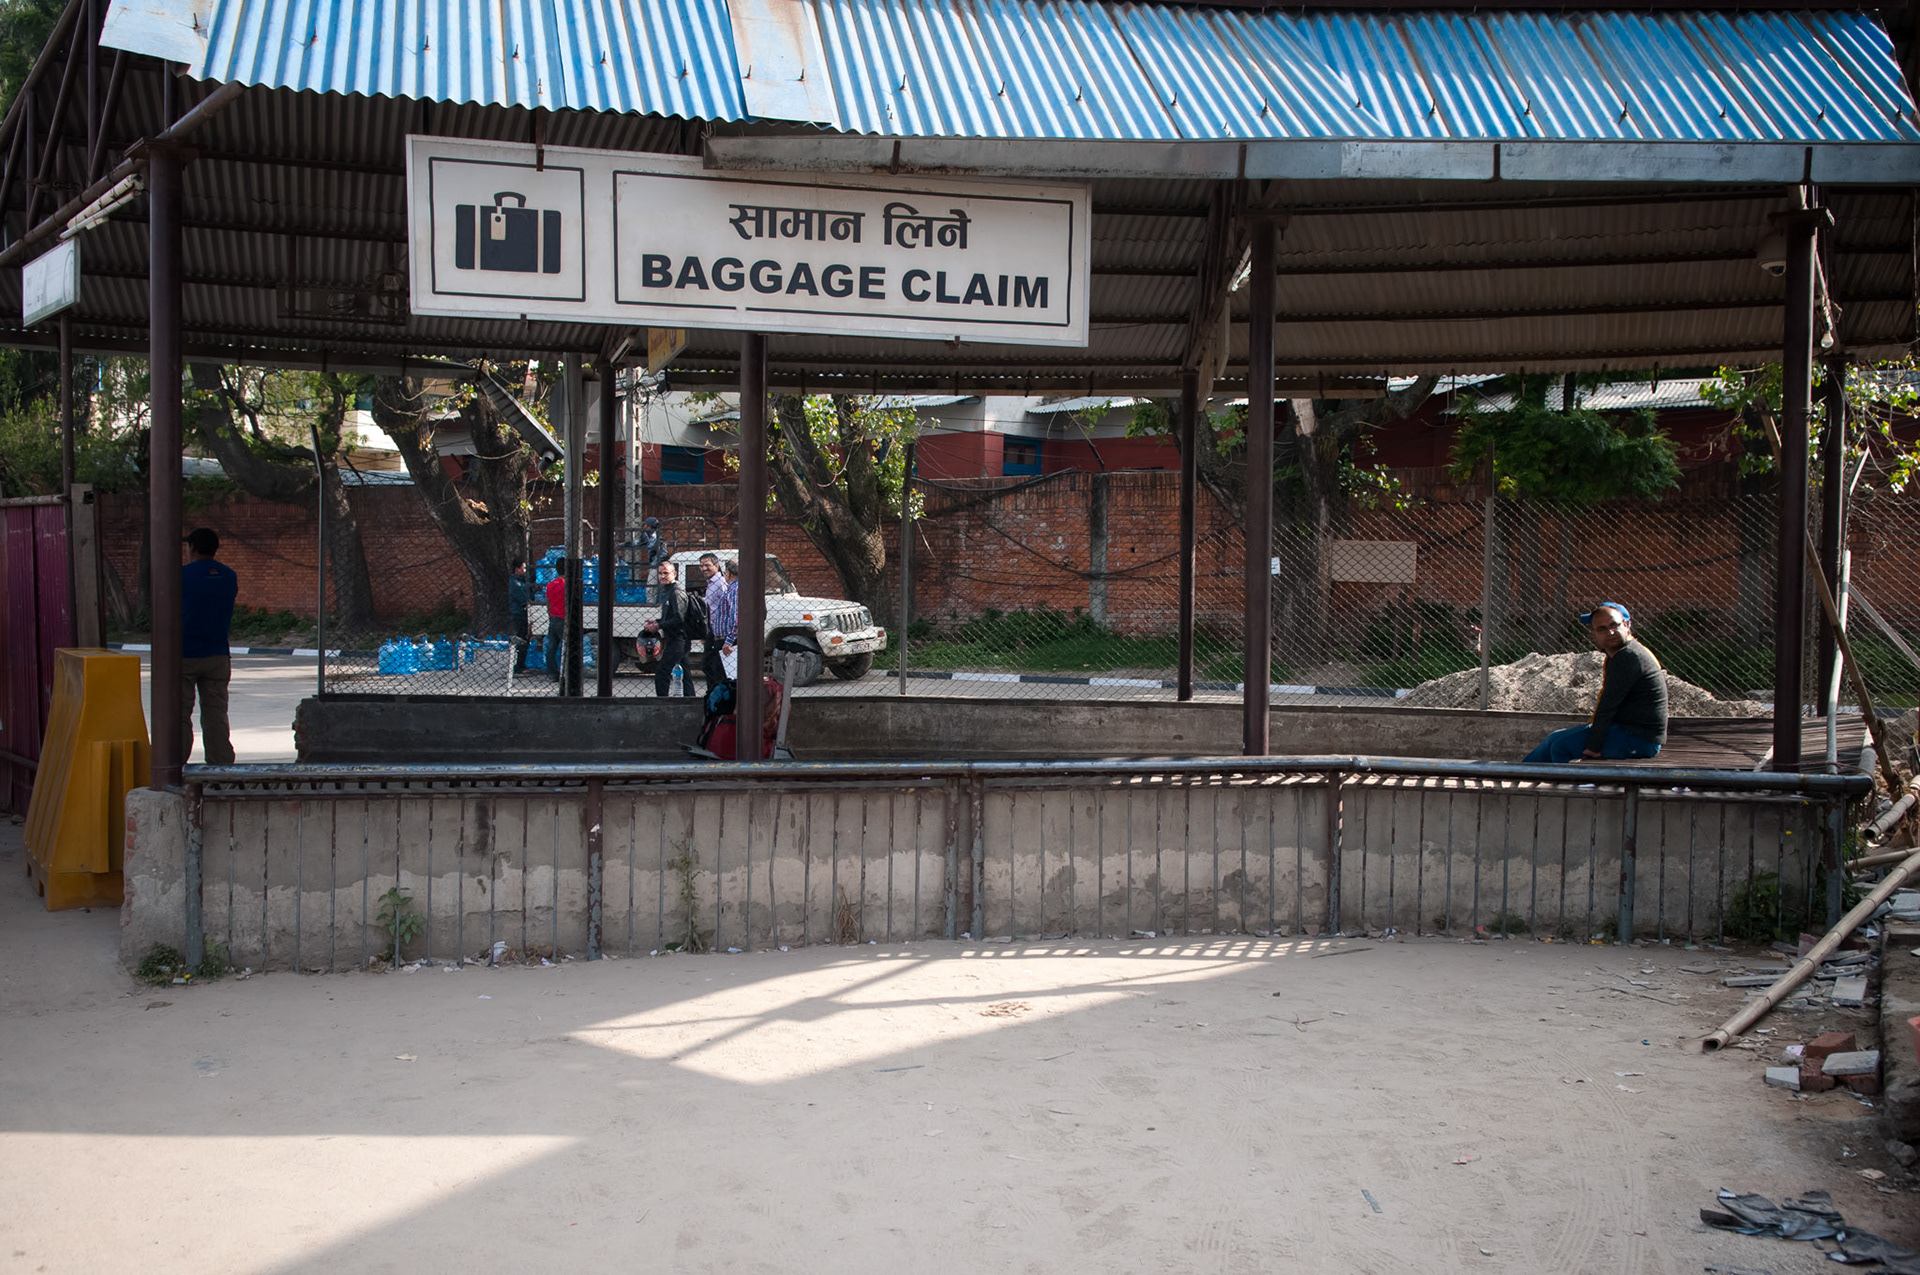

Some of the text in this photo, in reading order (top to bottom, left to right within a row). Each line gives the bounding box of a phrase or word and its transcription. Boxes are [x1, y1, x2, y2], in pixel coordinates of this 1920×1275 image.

[729, 201, 973, 250] सामान लिने
[641, 253, 1049, 309] BAGGAGE CLAIM
